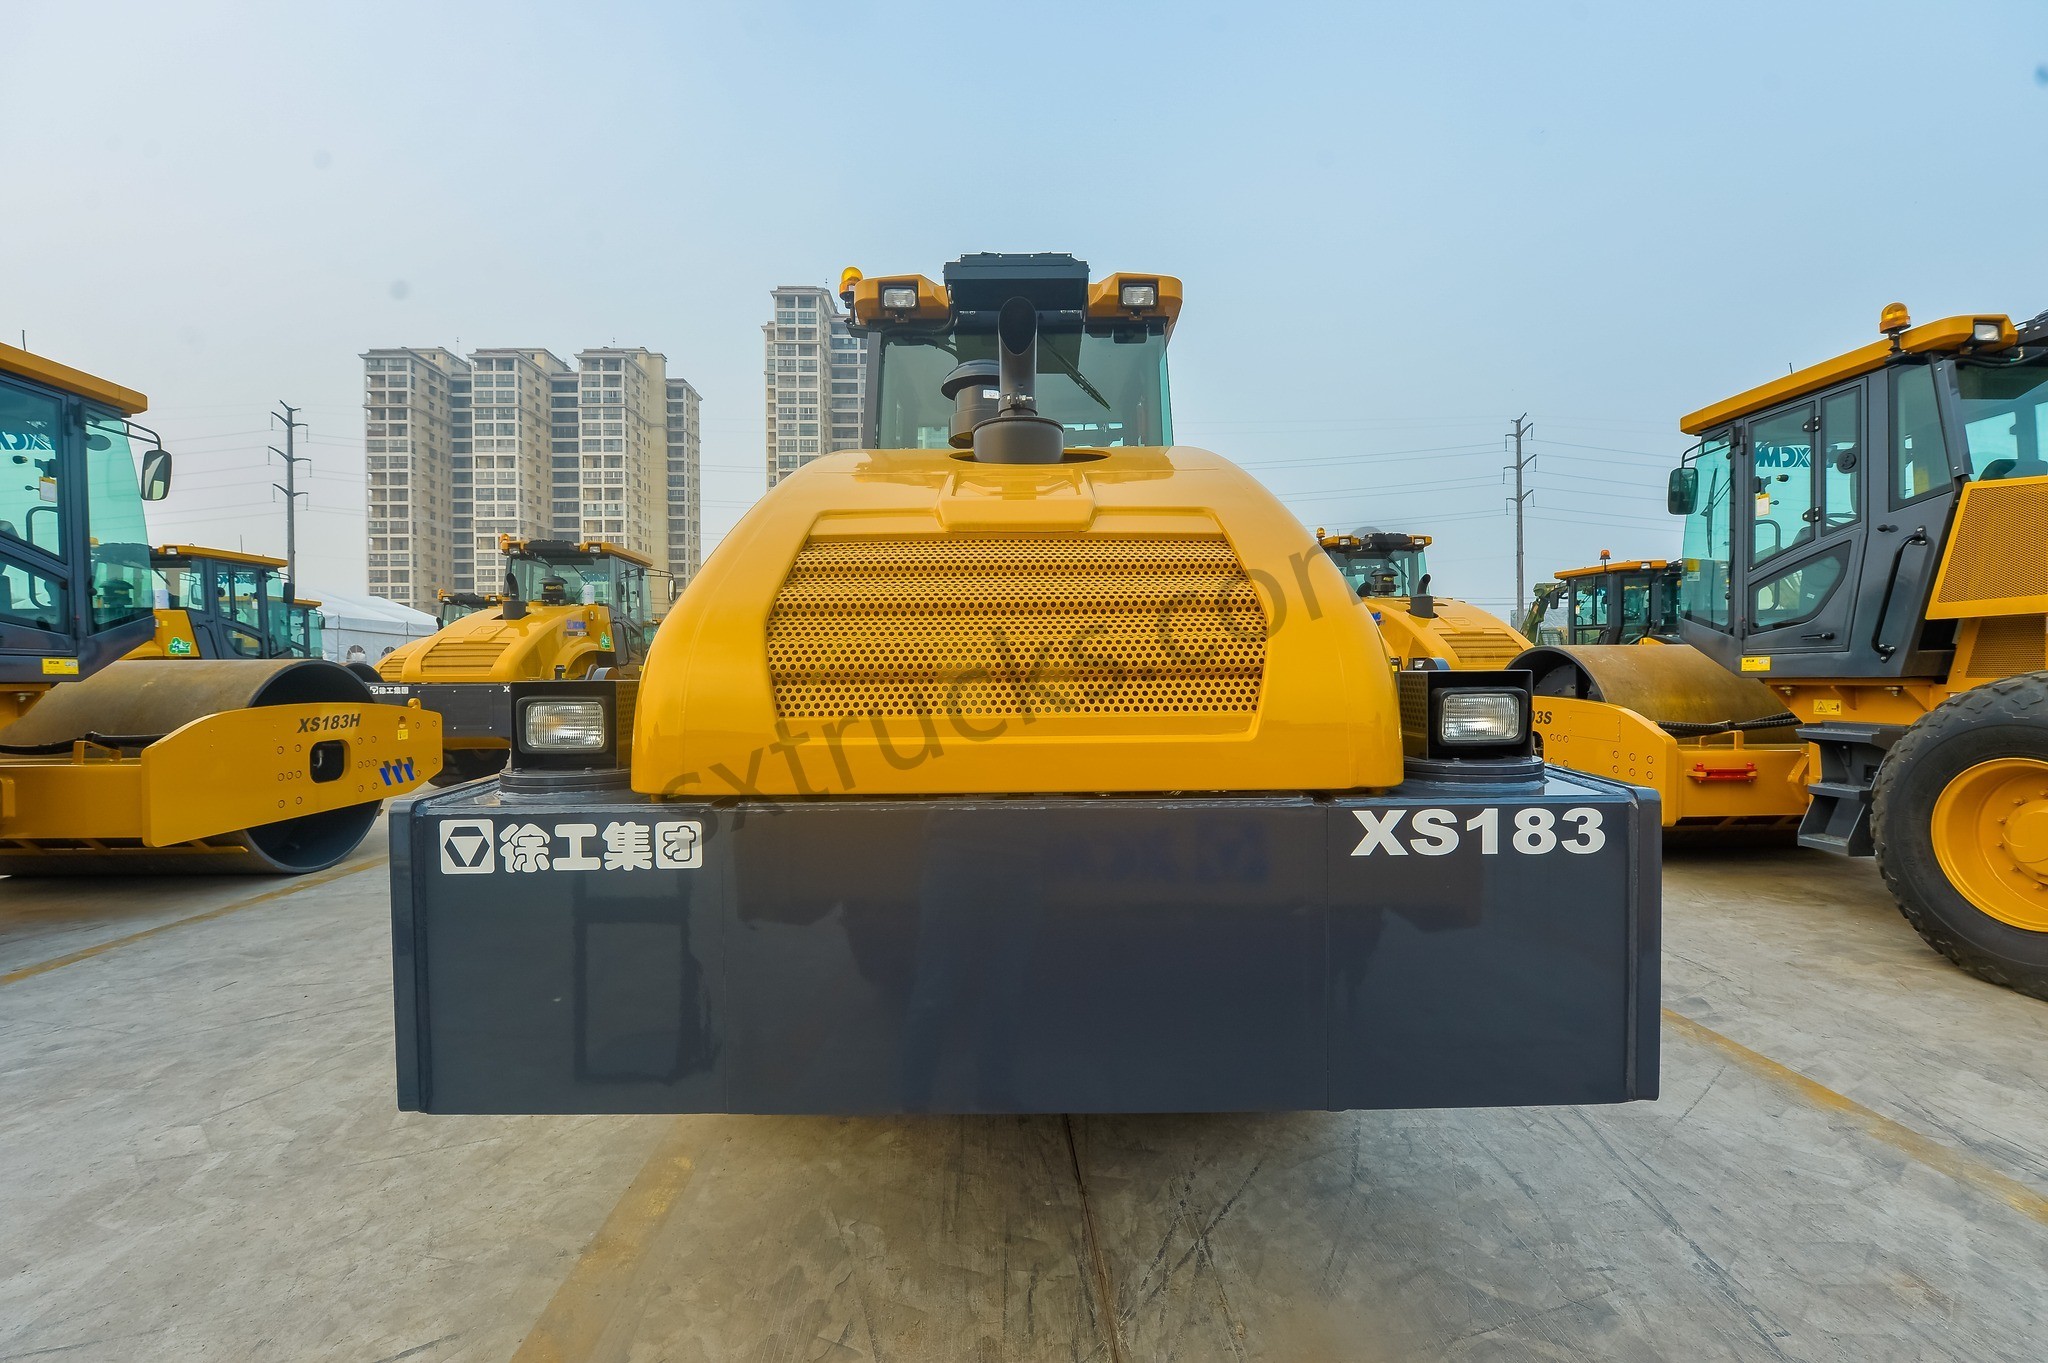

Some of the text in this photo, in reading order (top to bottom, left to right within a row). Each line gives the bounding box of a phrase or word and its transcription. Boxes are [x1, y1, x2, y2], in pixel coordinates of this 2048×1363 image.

[297, 713, 361, 733] XS183H
[499, 821, 703, 873] 徐工集团
[1350, 807, 1606, 856] XS183
